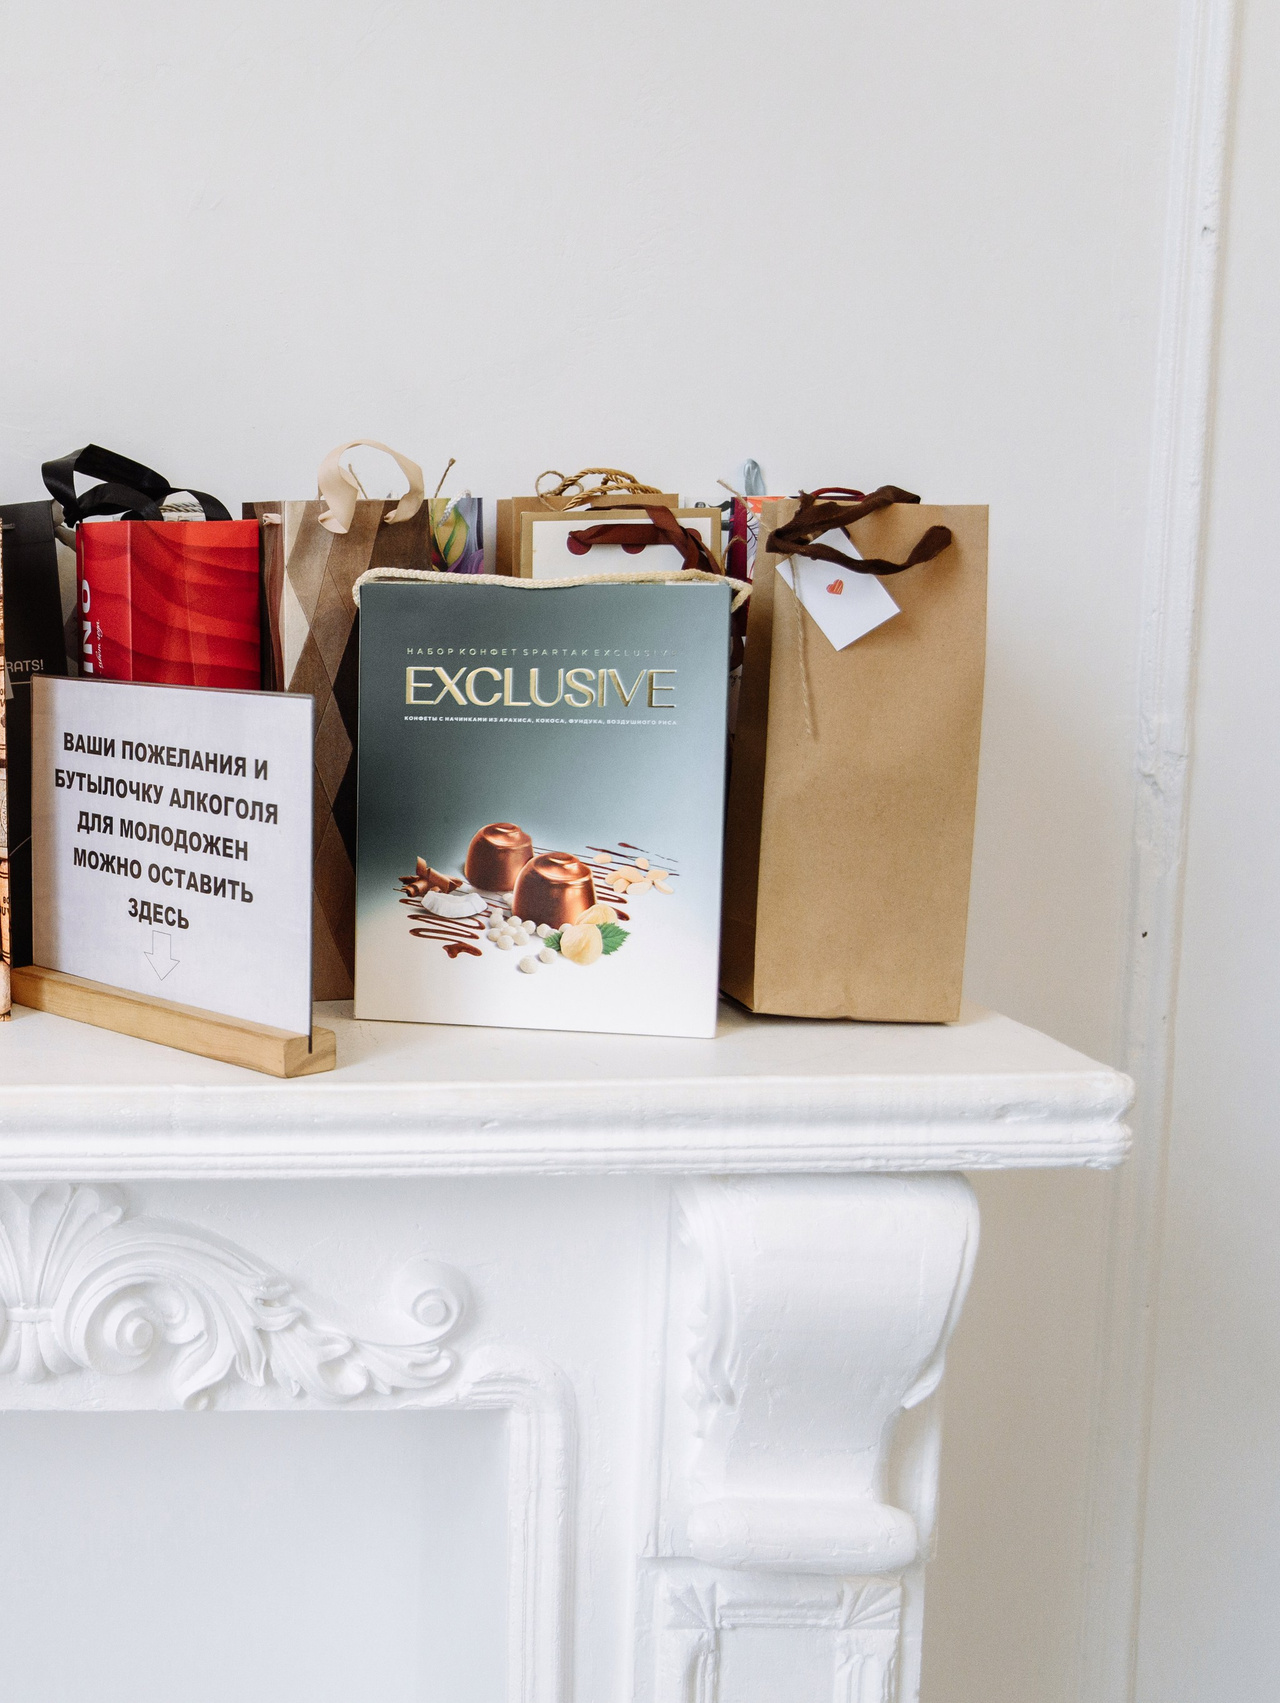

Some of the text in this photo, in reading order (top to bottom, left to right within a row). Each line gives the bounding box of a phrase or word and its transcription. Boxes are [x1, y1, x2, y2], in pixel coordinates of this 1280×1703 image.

[406, 647, 454, 655] НАБОР
[459, 648, 517, 656] КОНФЕТ
[523, 648, 589, 656] SPARTAK
[405, 666, 677, 708] EXCLUSIVE
[63, 731, 268, 781] ВАШИ ПОЖЕЛАНИЯ И
[54, 768, 279, 825] БУТЫЛОЧКУ АЛКОГОЛЯ
[77, 810, 248, 861] ДЛЯ МОЛОДОЖЕН
[73, 846, 254, 904] МОЖНО ОСТАВИТЬ
[127, 897, 190, 930] ЗДЕСЬ
